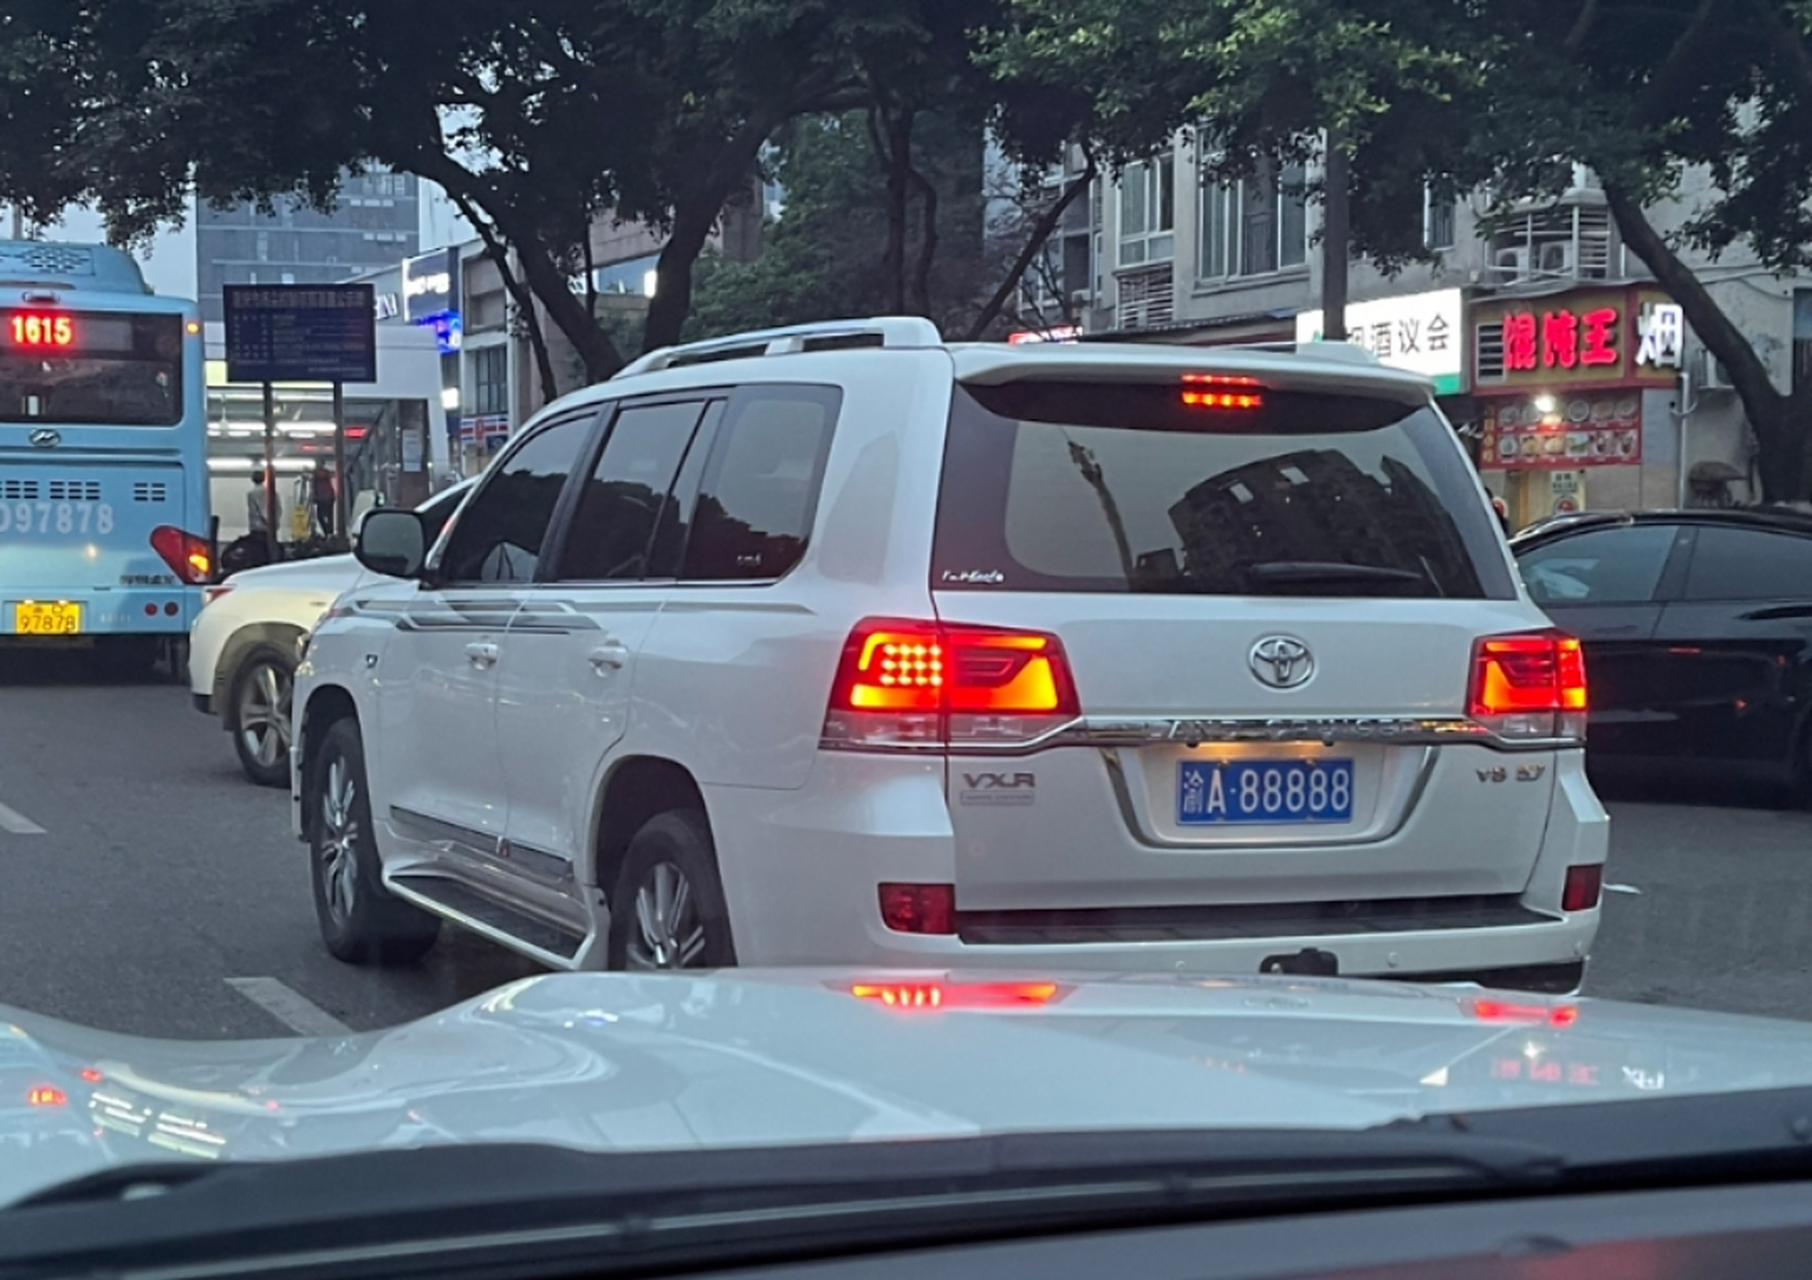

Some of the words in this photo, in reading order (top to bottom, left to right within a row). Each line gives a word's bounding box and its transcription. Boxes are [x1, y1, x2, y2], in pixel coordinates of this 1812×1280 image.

[12, 315, 72, 345] 1615
[1635, 302, 1683, 368] 烟
[20, 615, 77, 630] 97878
[961, 772, 1036, 789] VXR
